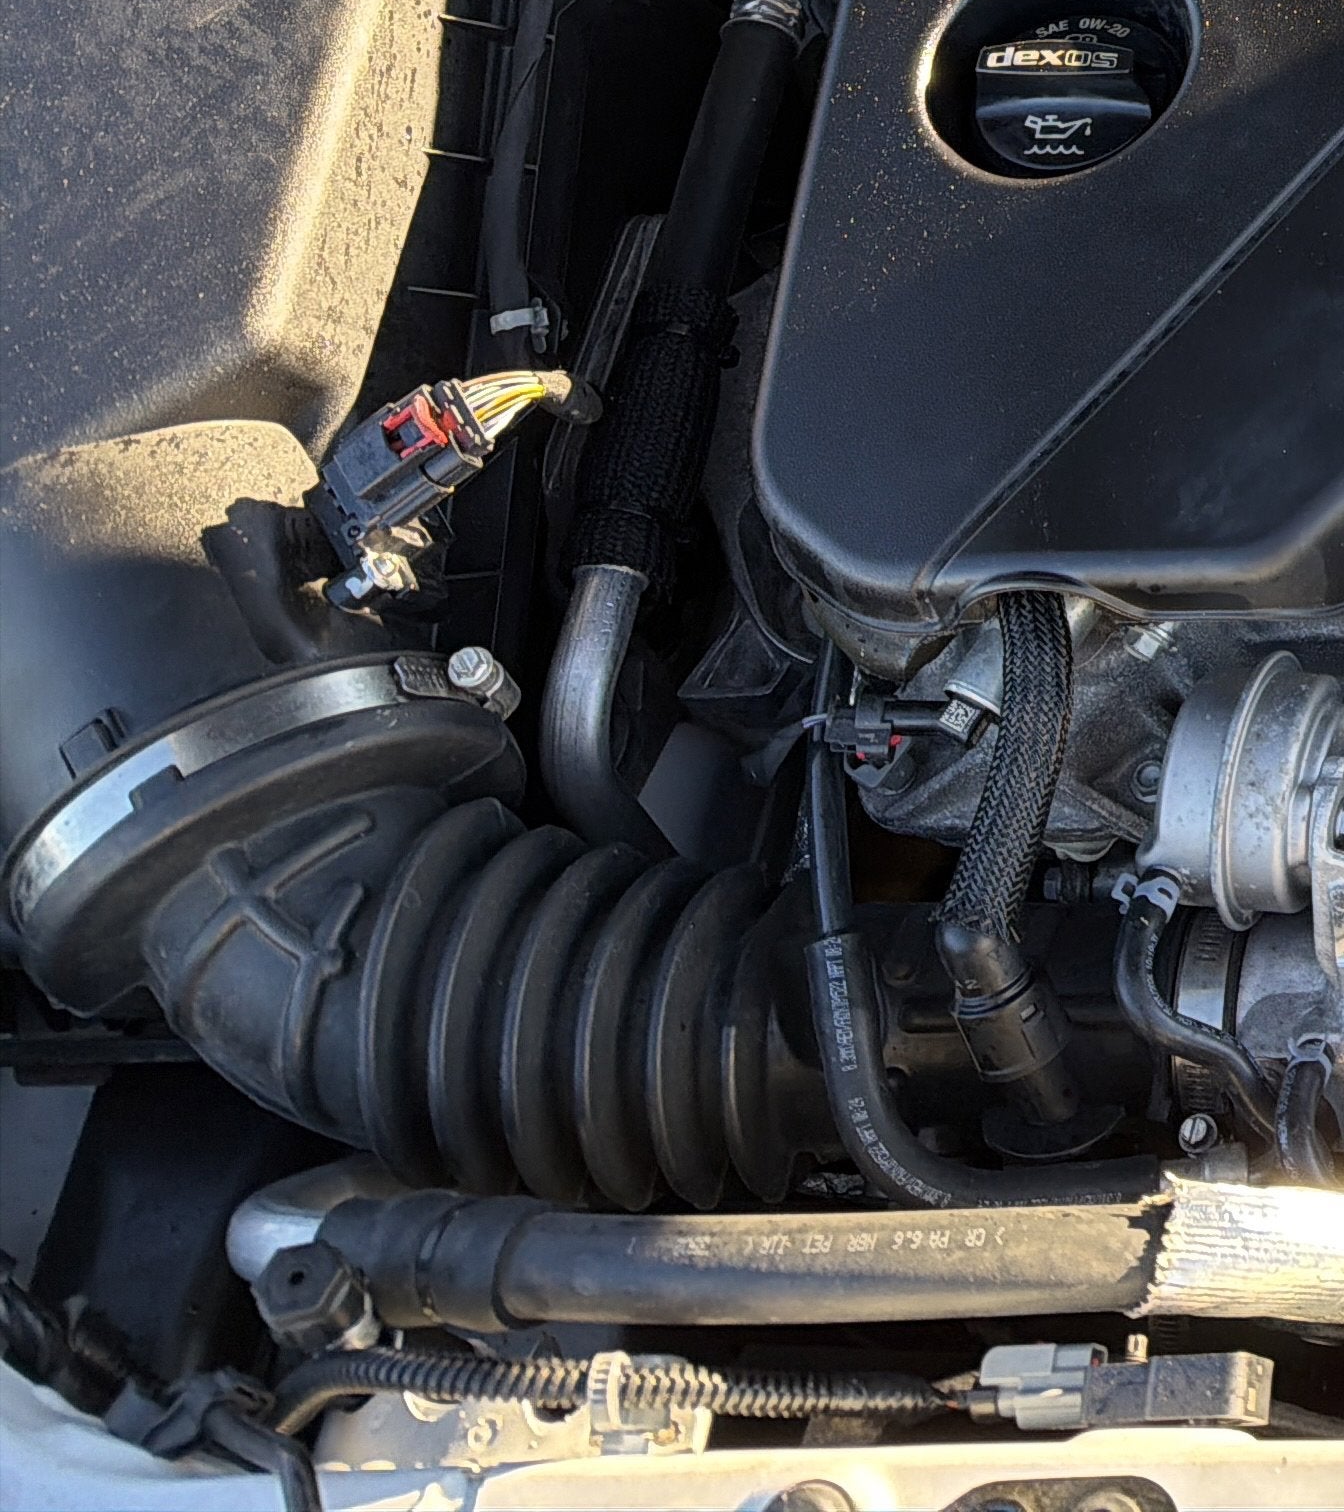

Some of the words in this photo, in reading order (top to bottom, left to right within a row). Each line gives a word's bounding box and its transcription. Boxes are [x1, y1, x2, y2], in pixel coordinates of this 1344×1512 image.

[1035, 19, 1069, 39] SAE
[1079, 17, 1131, 38] 0W-20
[986, 46, 1119, 68] dexos
[802, 1234, 833, 1254] PET
[847, 1233, 878, 1252] NBR
